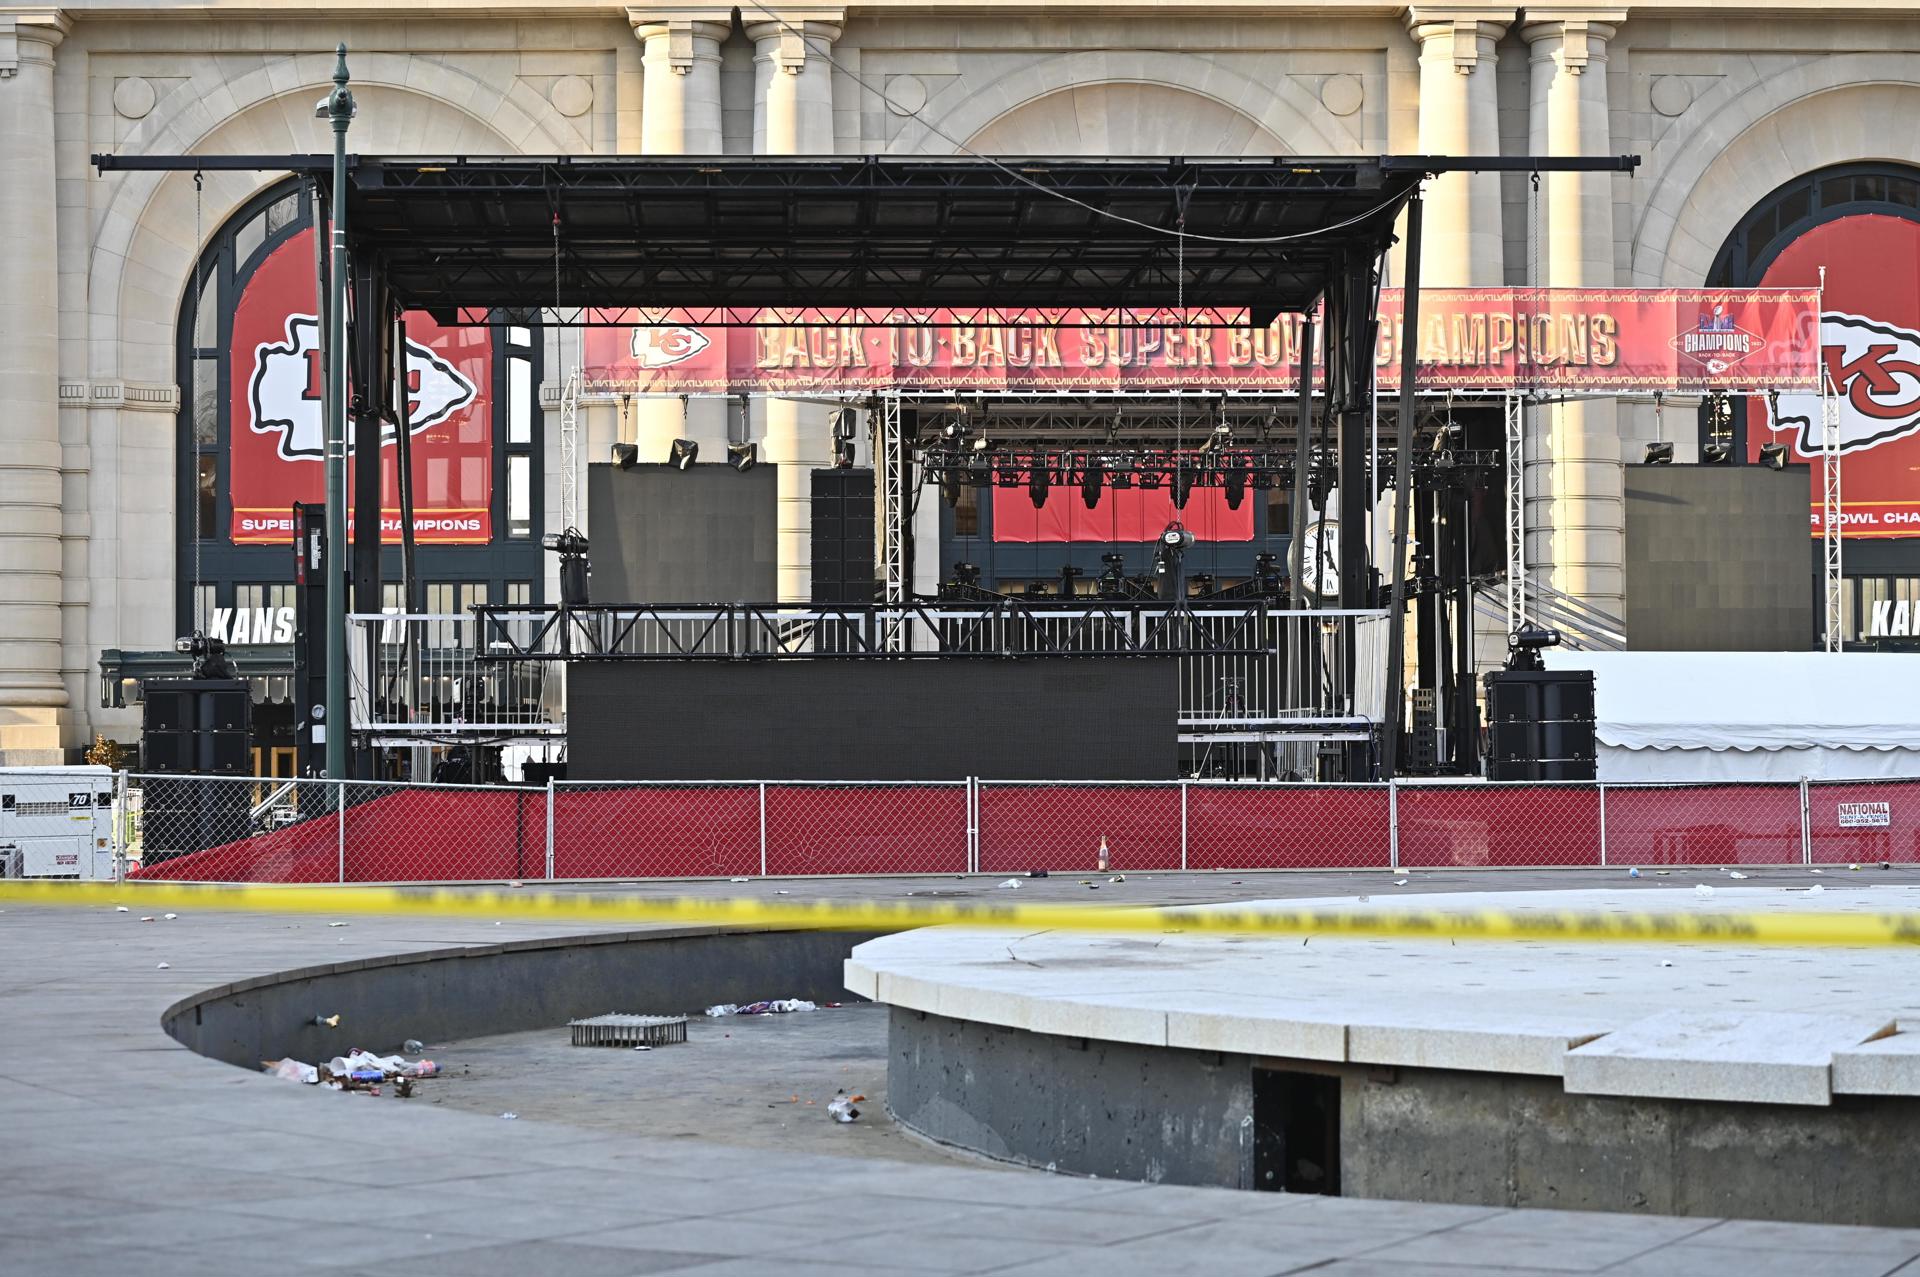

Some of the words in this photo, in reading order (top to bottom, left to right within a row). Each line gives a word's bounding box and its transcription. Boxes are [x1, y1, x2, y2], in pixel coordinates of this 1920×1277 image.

[1079, 314, 1213, 367] SUPER
[1226, 312, 1323, 367] BOW
[1685, 333, 1749, 353] CHAMPIONS
[241, 519, 294, 531] SUPE
[380, 519, 481, 531] HAMPIONS
[209, 606, 297, 644] KANS
[72, 794, 88, 805] 70
[1840, 803, 1888, 815] NATIONAL
